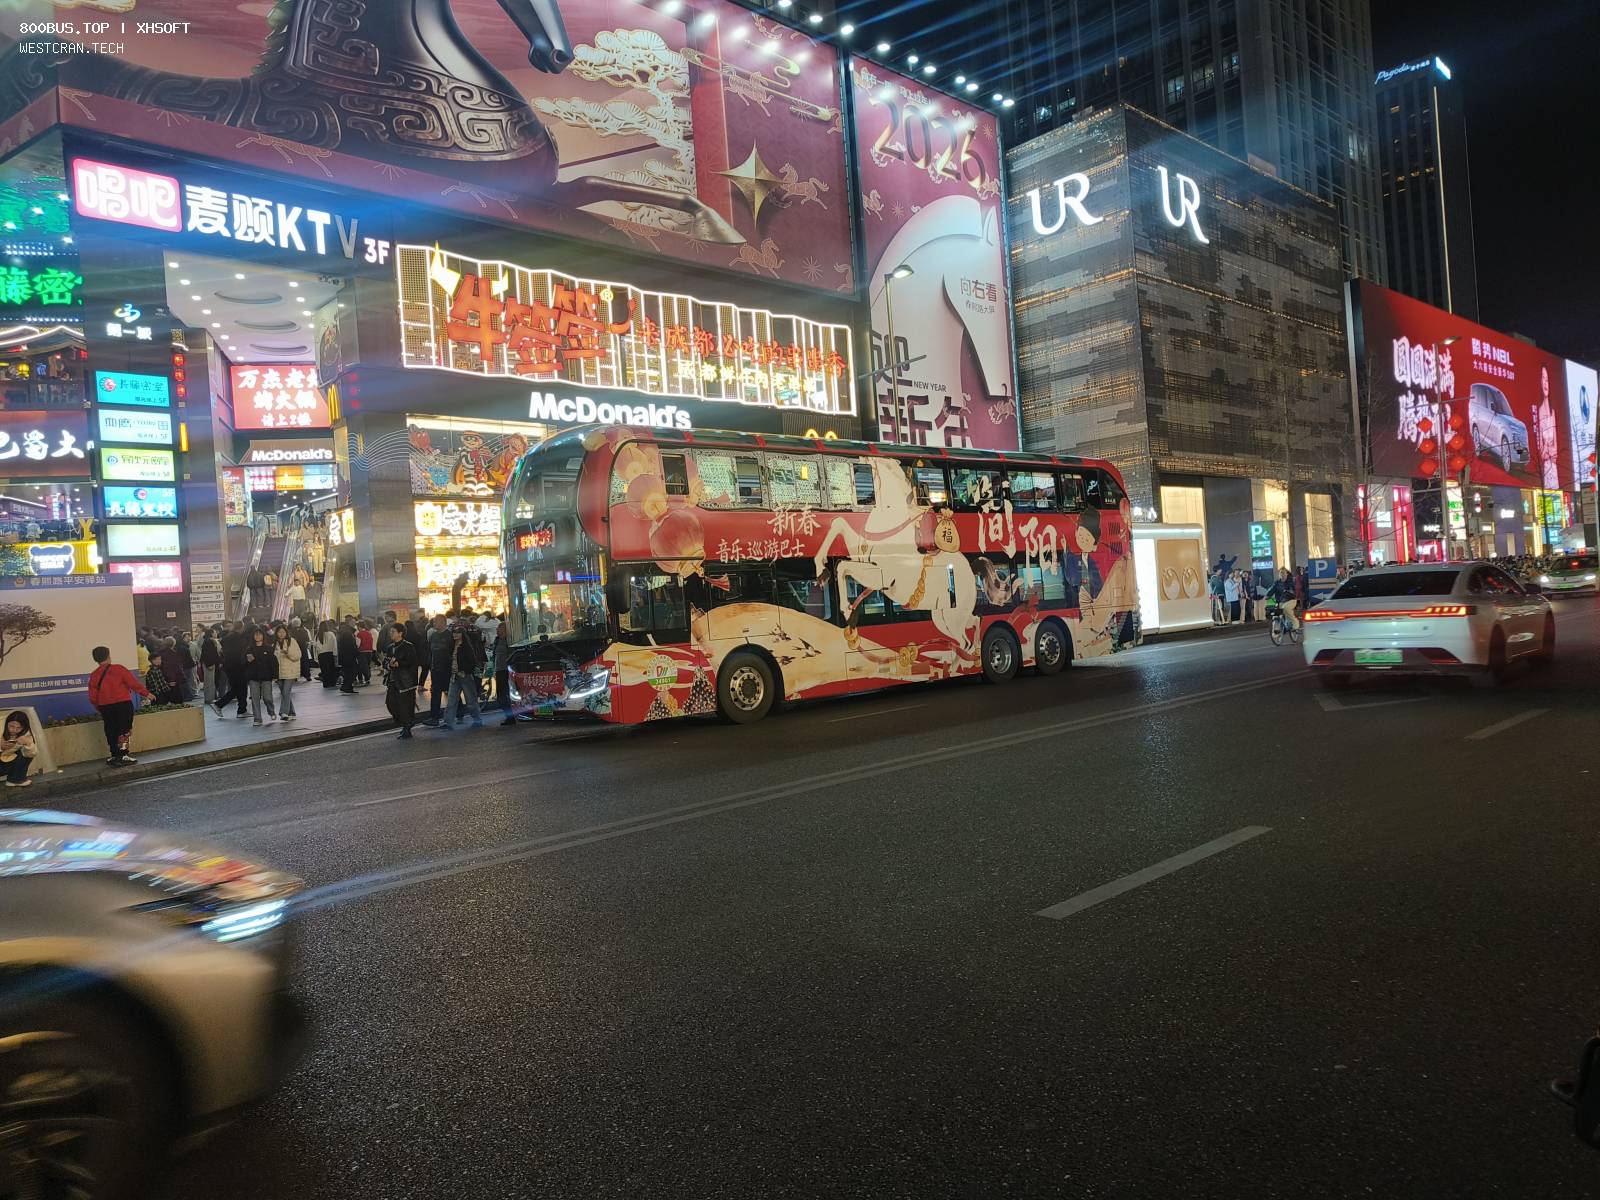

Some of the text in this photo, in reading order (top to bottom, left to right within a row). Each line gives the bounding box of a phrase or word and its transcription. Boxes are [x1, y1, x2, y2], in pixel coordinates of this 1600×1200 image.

[869, 99, 987, 189] 2026
[1026, 172, 1103, 235] UR
[1157, 165, 1210, 244] UR
[364, 237, 391, 265] 3F
[960, 277, 997, 302] 向右看
[913, 381, 947, 393] NEW YEAR
[529, 391, 692, 430] McDonald's
[251, 448, 334, 462] McDonald's
[767, 502, 821, 538] 新春
[1251, 525, 1263, 541] P
[942, 527, 953, 544] 福
[716, 538, 806, 567] 音乐巡游巴士
[1315, 560, 1328, 577] P
